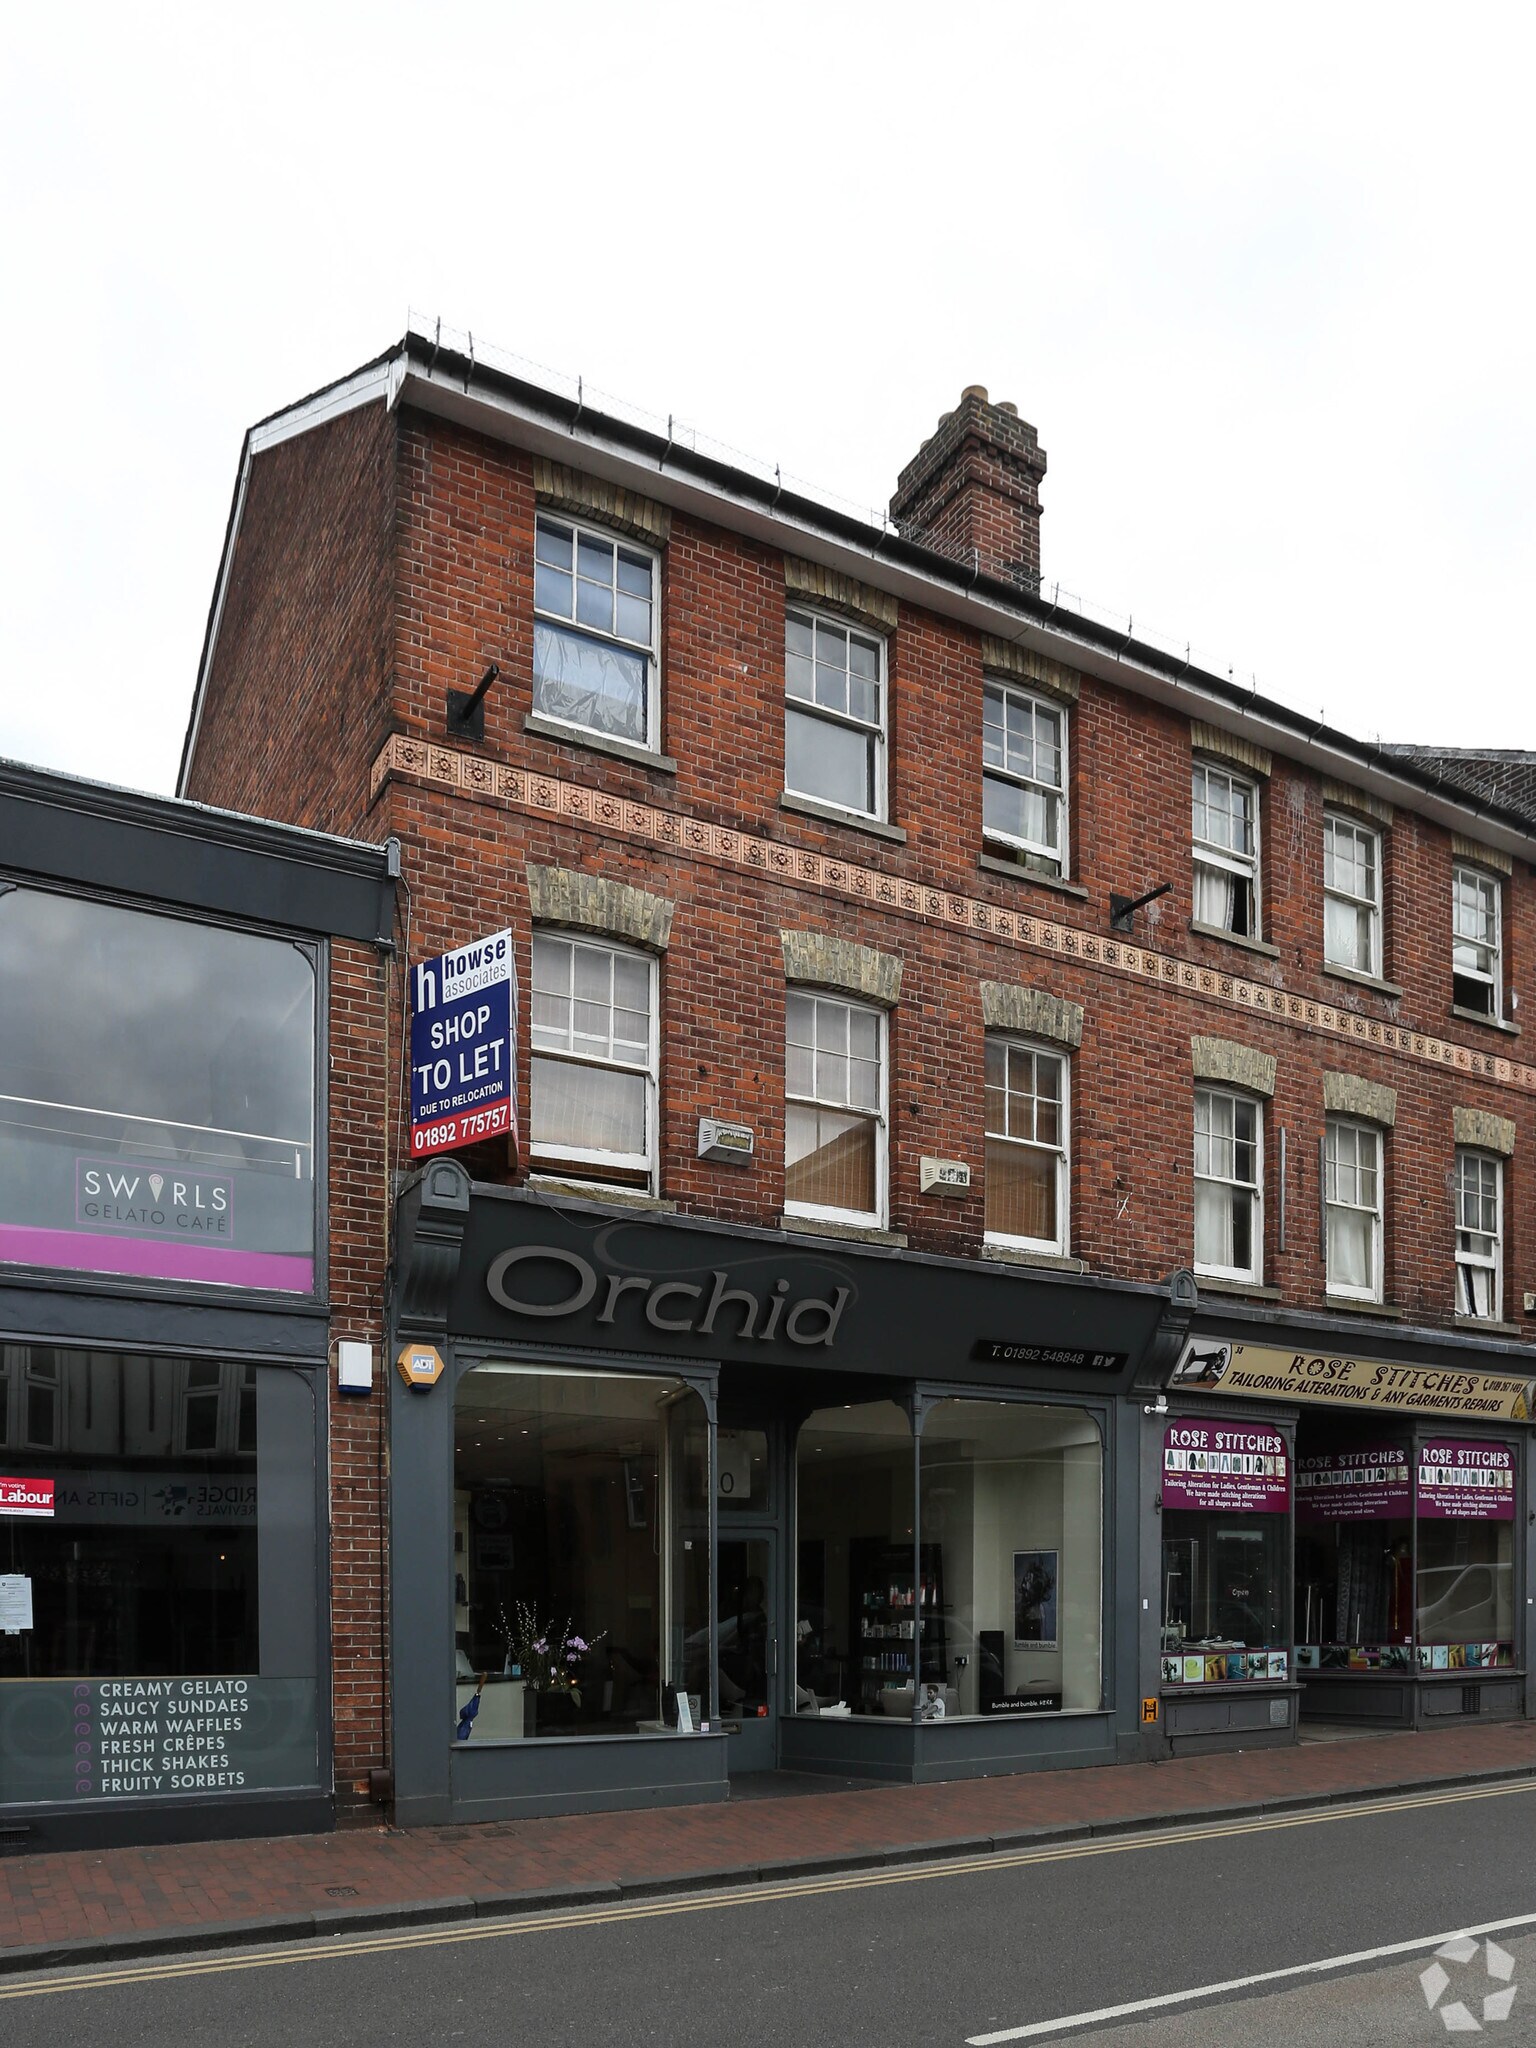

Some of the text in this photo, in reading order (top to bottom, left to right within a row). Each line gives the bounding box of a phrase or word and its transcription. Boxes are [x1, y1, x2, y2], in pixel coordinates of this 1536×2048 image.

[444, 939, 506, 980] howse
[445, 963, 507, 999] associates
[430, 1004, 491, 1050] SHOP
[418, 1038, 505, 1095] TO LET
[420, 1080, 503, 1117] DUE TO RELOCATION
[415, 1105, 508, 1150] 01892 775757
[84, 1202, 226, 1232] GELATO CAFÉ
[486, 1245, 850, 1346] Orchid
[992, 1345, 1085, 1364] T. 01892 548848
[1235, 1346, 1244, 1355] 38
[413, 1358, 434, 1370] ADT
[1288, 1354, 1480, 1395] ROSE STITCHES
[1228, 1371, 1504, 1412] TAILORING ALTERATIONS & ANY GARMENTS REPAIRS
[1170, 1428, 1282, 1453] ROSE STITCHES
[1298, 1450, 1405, 1469] ROSE STITCHES
[1422, 1448, 1510, 1467] ROSE STITCHES
[8, 1482, 26, 1490] voting
[1164, 1479, 1187, 1489] Tailoring
[1187, 1480, 1211, 1489] Alteration
[1237, 1482, 1261, 1491] Gentleman
[1267, 1484, 1286, 1492] Children
[1186, 1489, 1194, 1497] We
[1208, 1490, 1220, 1498] made
[1221, 1491, 1241, 1500] stitching
[1242, 1492, 1266, 1500] alterations
[0, 1489, 54, 1504] Labour
[1215, 1500, 1231, 1508] shapes
[100, 1680, 248, 1697] CREAMY GELATO
[100, 1698, 249, 1716] SAUCY SUNDAES
[100, 1717, 243, 1736] WARM WAFFLES
[101, 1734, 226, 1755] FRESH CRÊPES
[101, 1754, 229, 1773] THICK SHAKES
[102, 1772, 245, 1792] FRUITY SORBETS
